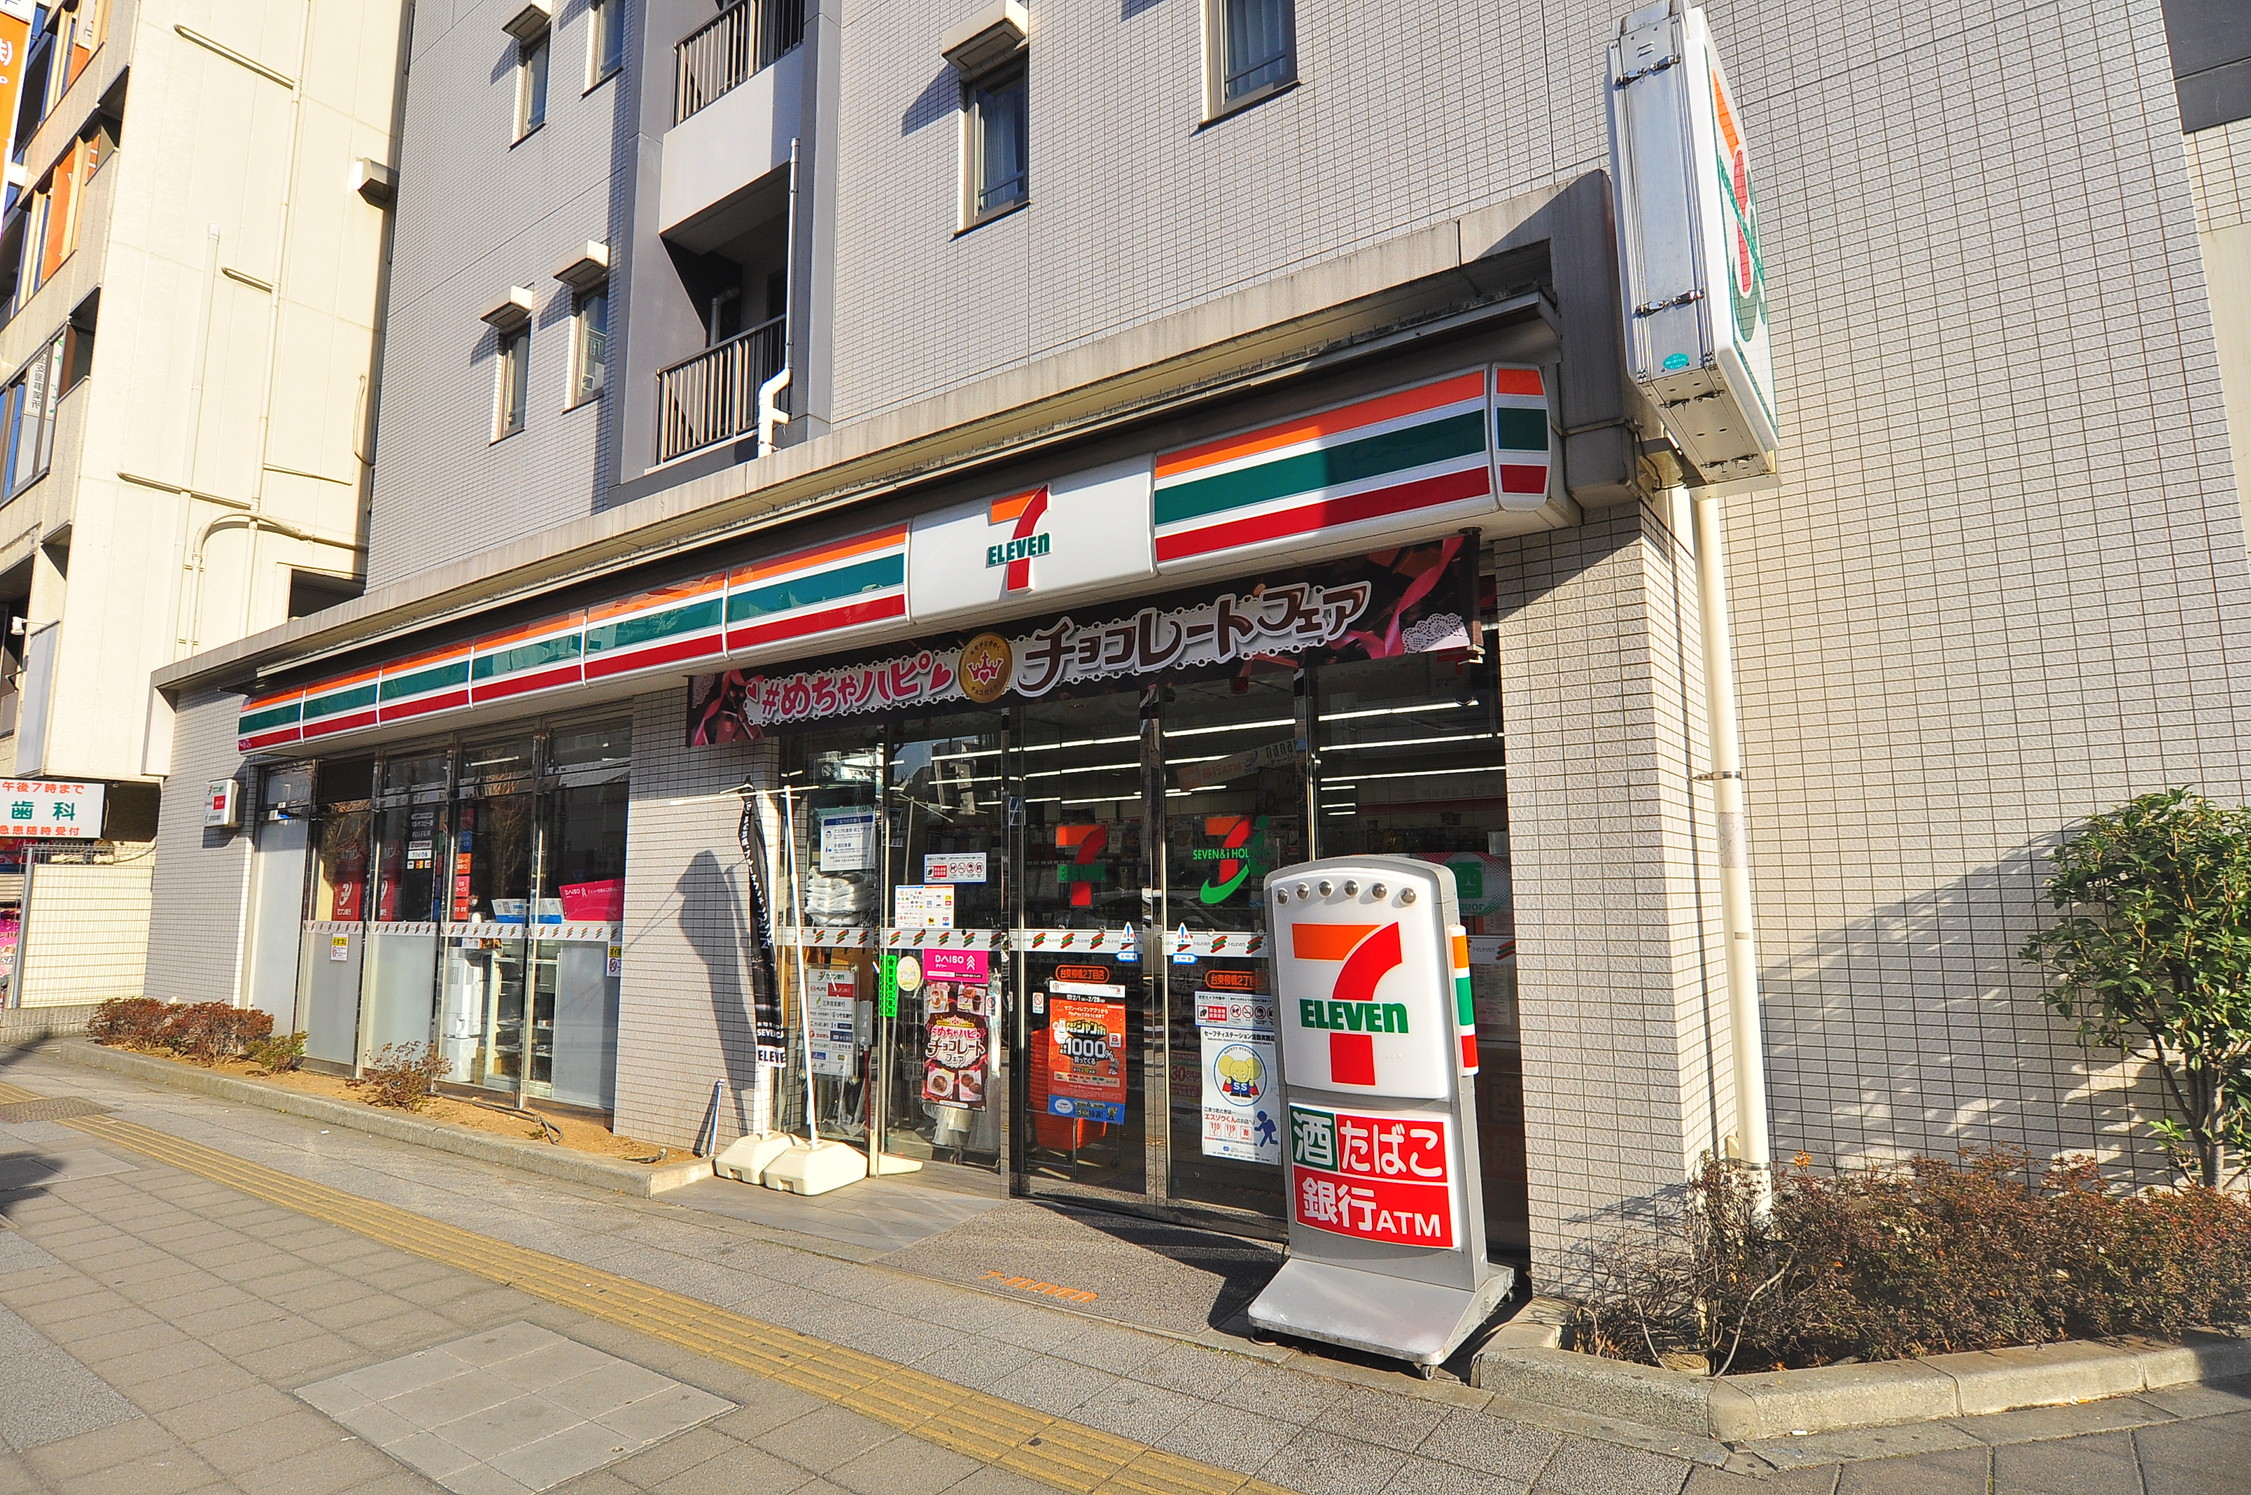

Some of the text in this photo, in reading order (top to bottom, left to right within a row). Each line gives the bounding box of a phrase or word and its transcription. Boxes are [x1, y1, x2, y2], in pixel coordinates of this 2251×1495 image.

[761, 580, 1372, 717] #めちゃハピ チョコレートフェア
[2, 781, 85, 795] 午後7時まで
[0, 825, 80, 836] 急患随時受付
[935, 954, 965, 964] DAISO
[926, 1038, 986, 1057] チョコレート
[757, 1049, 787, 1064] ELEVE
[945, 1053, 964, 1064] フェア
[1233, 1082, 1248, 1091] SS
[1292, 1111, 1334, 1167] 酒
[1339, 1119, 1443, 1177] たばこ
